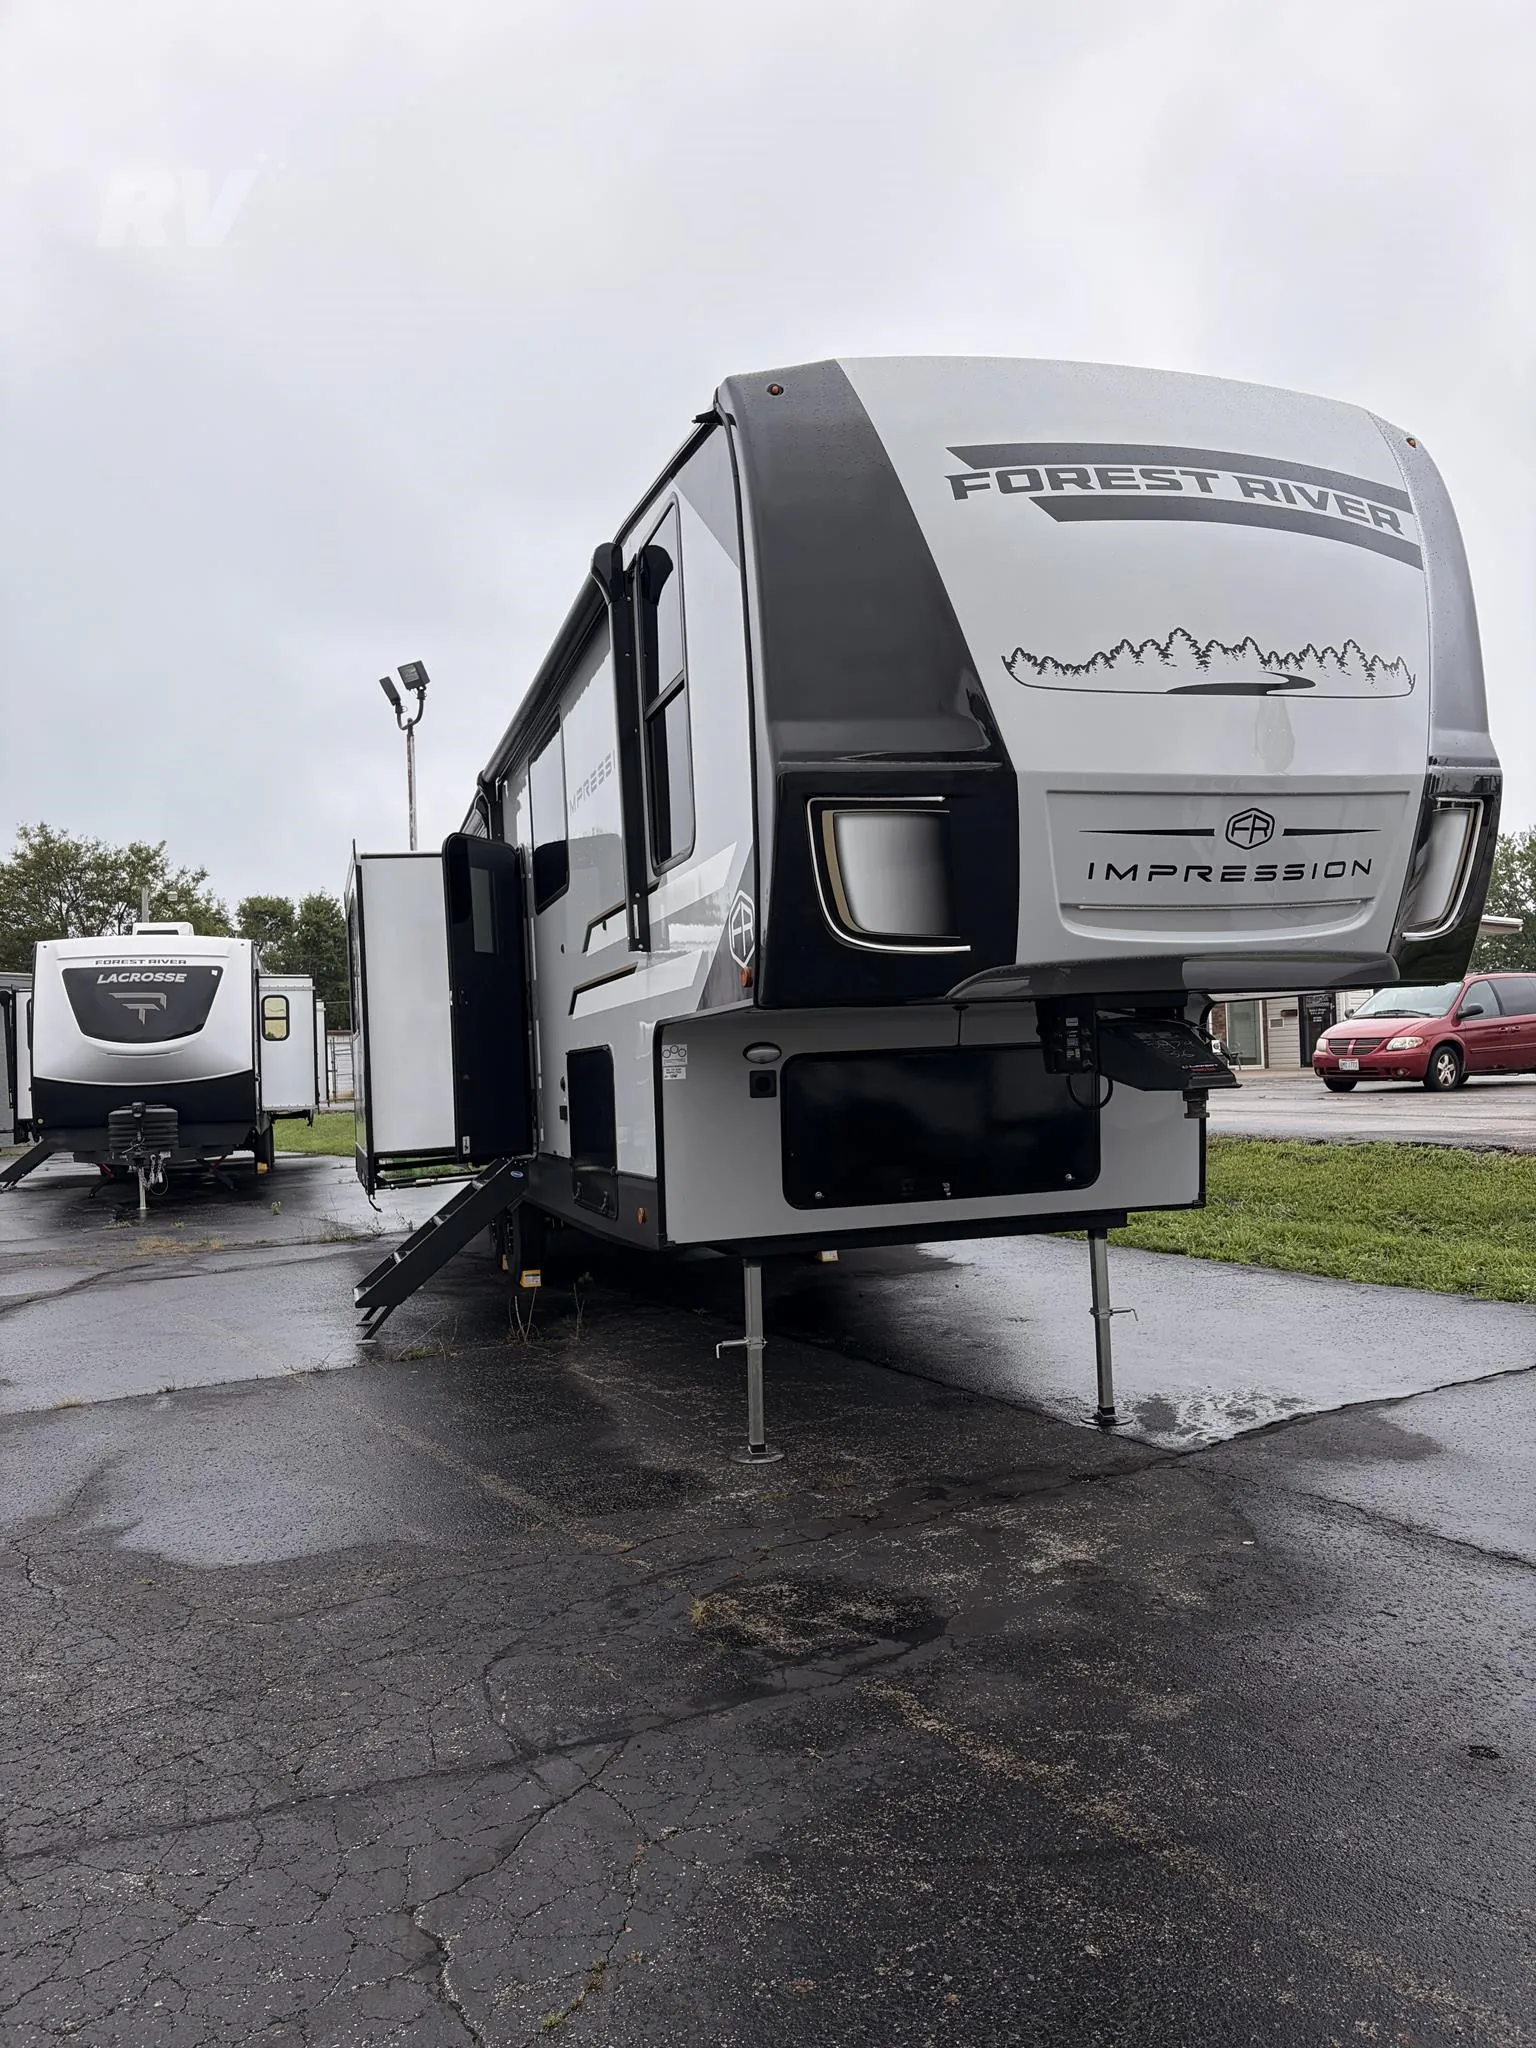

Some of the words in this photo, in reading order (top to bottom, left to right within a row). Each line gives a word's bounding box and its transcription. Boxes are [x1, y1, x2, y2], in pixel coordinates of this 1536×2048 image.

[944, 466, 1221, 500] FOREST
[1232, 475, 1405, 536] RIVER
[1087, 859, 1372, 882] IMPRESSION
[97, 972, 188, 985] LACROSSE
